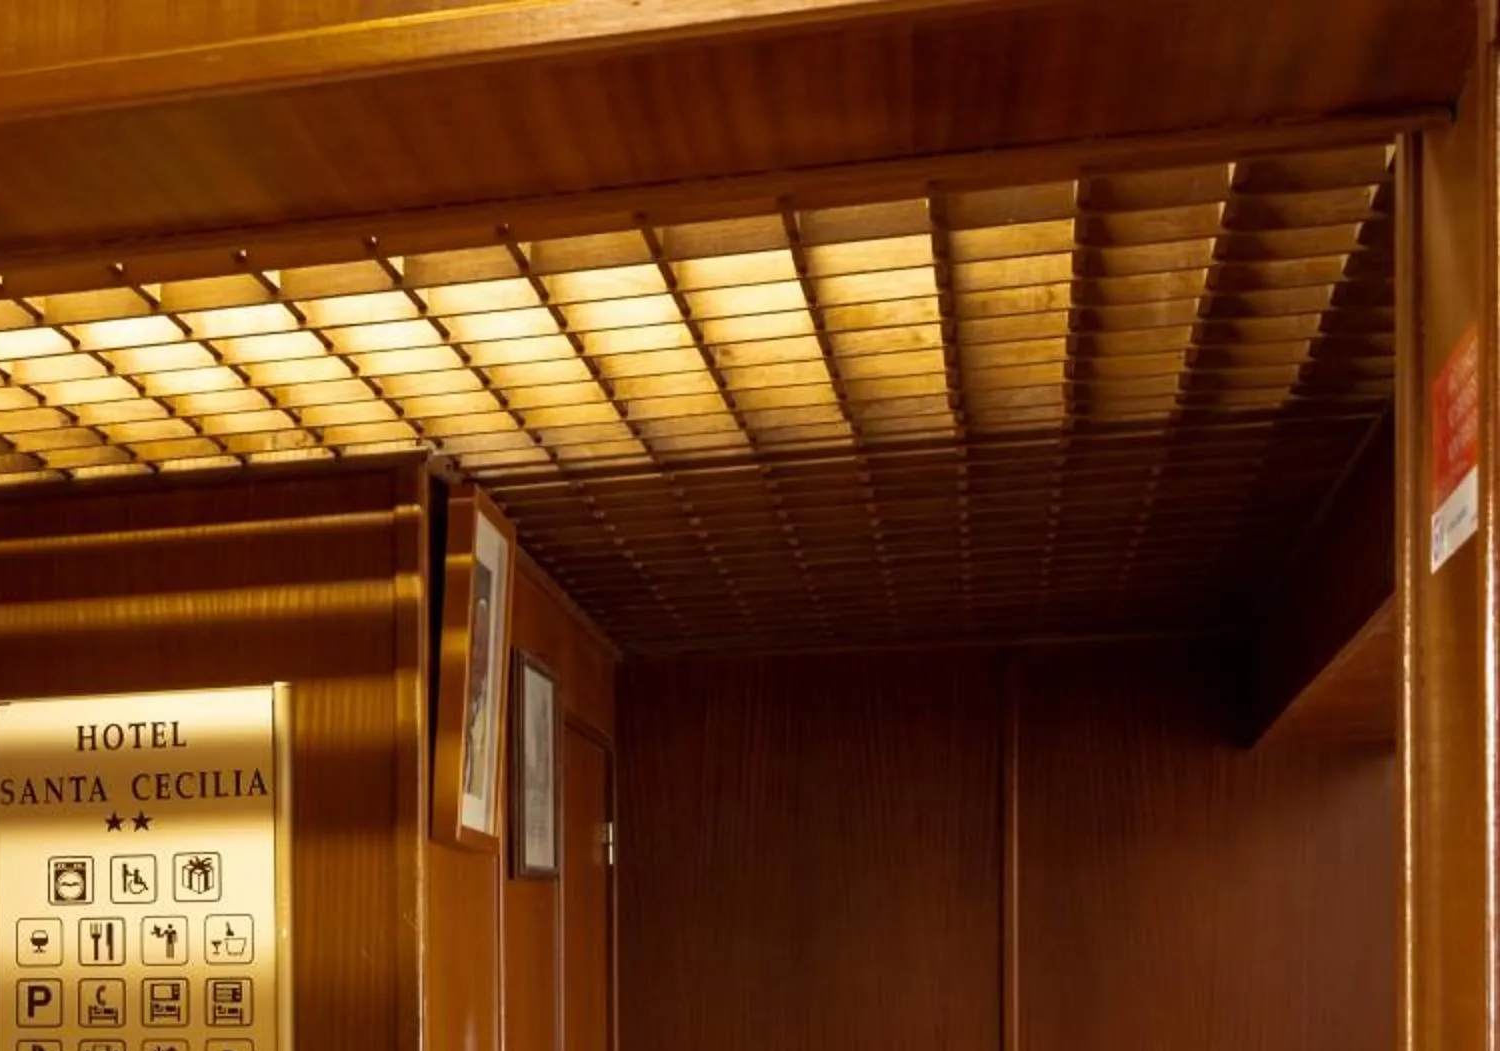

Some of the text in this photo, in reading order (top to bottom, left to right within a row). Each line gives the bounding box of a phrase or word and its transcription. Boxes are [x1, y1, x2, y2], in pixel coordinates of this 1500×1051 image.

[75, 720, 187, 752] HOTEL
[0, 767, 269, 806] SANTA CECILIA
